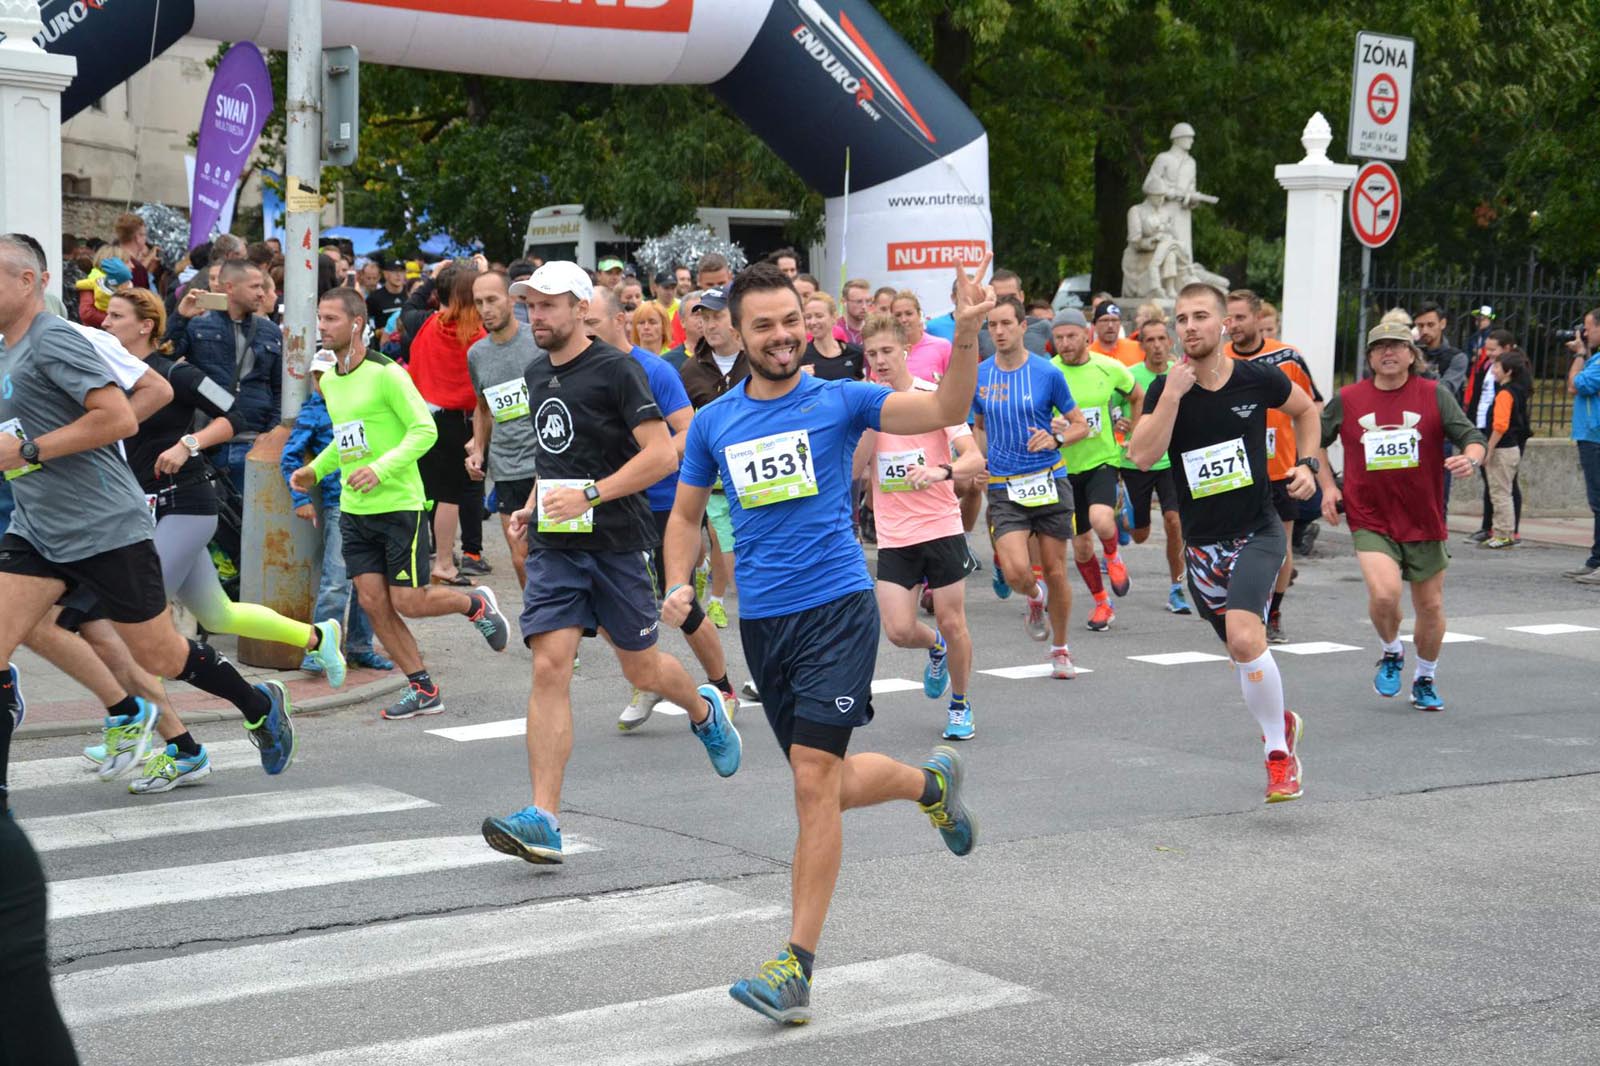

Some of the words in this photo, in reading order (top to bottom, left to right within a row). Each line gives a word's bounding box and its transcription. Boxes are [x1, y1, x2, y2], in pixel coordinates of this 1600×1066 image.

[793, 25, 861, 94] ENDURO
[1363, 40, 1408, 69] ZÓNA
[215, 94, 249, 125] SWAN
[895, 245, 984, 265] NUTREND
[495, 391, 521, 410] 397
[341, 433, 355, 448] 41
[1375, 442, 1409, 456] 485
[745, 453, 797, 483] 153
[1198, 456, 1235, 479] 457
[1017, 484, 1047, 499] 349
